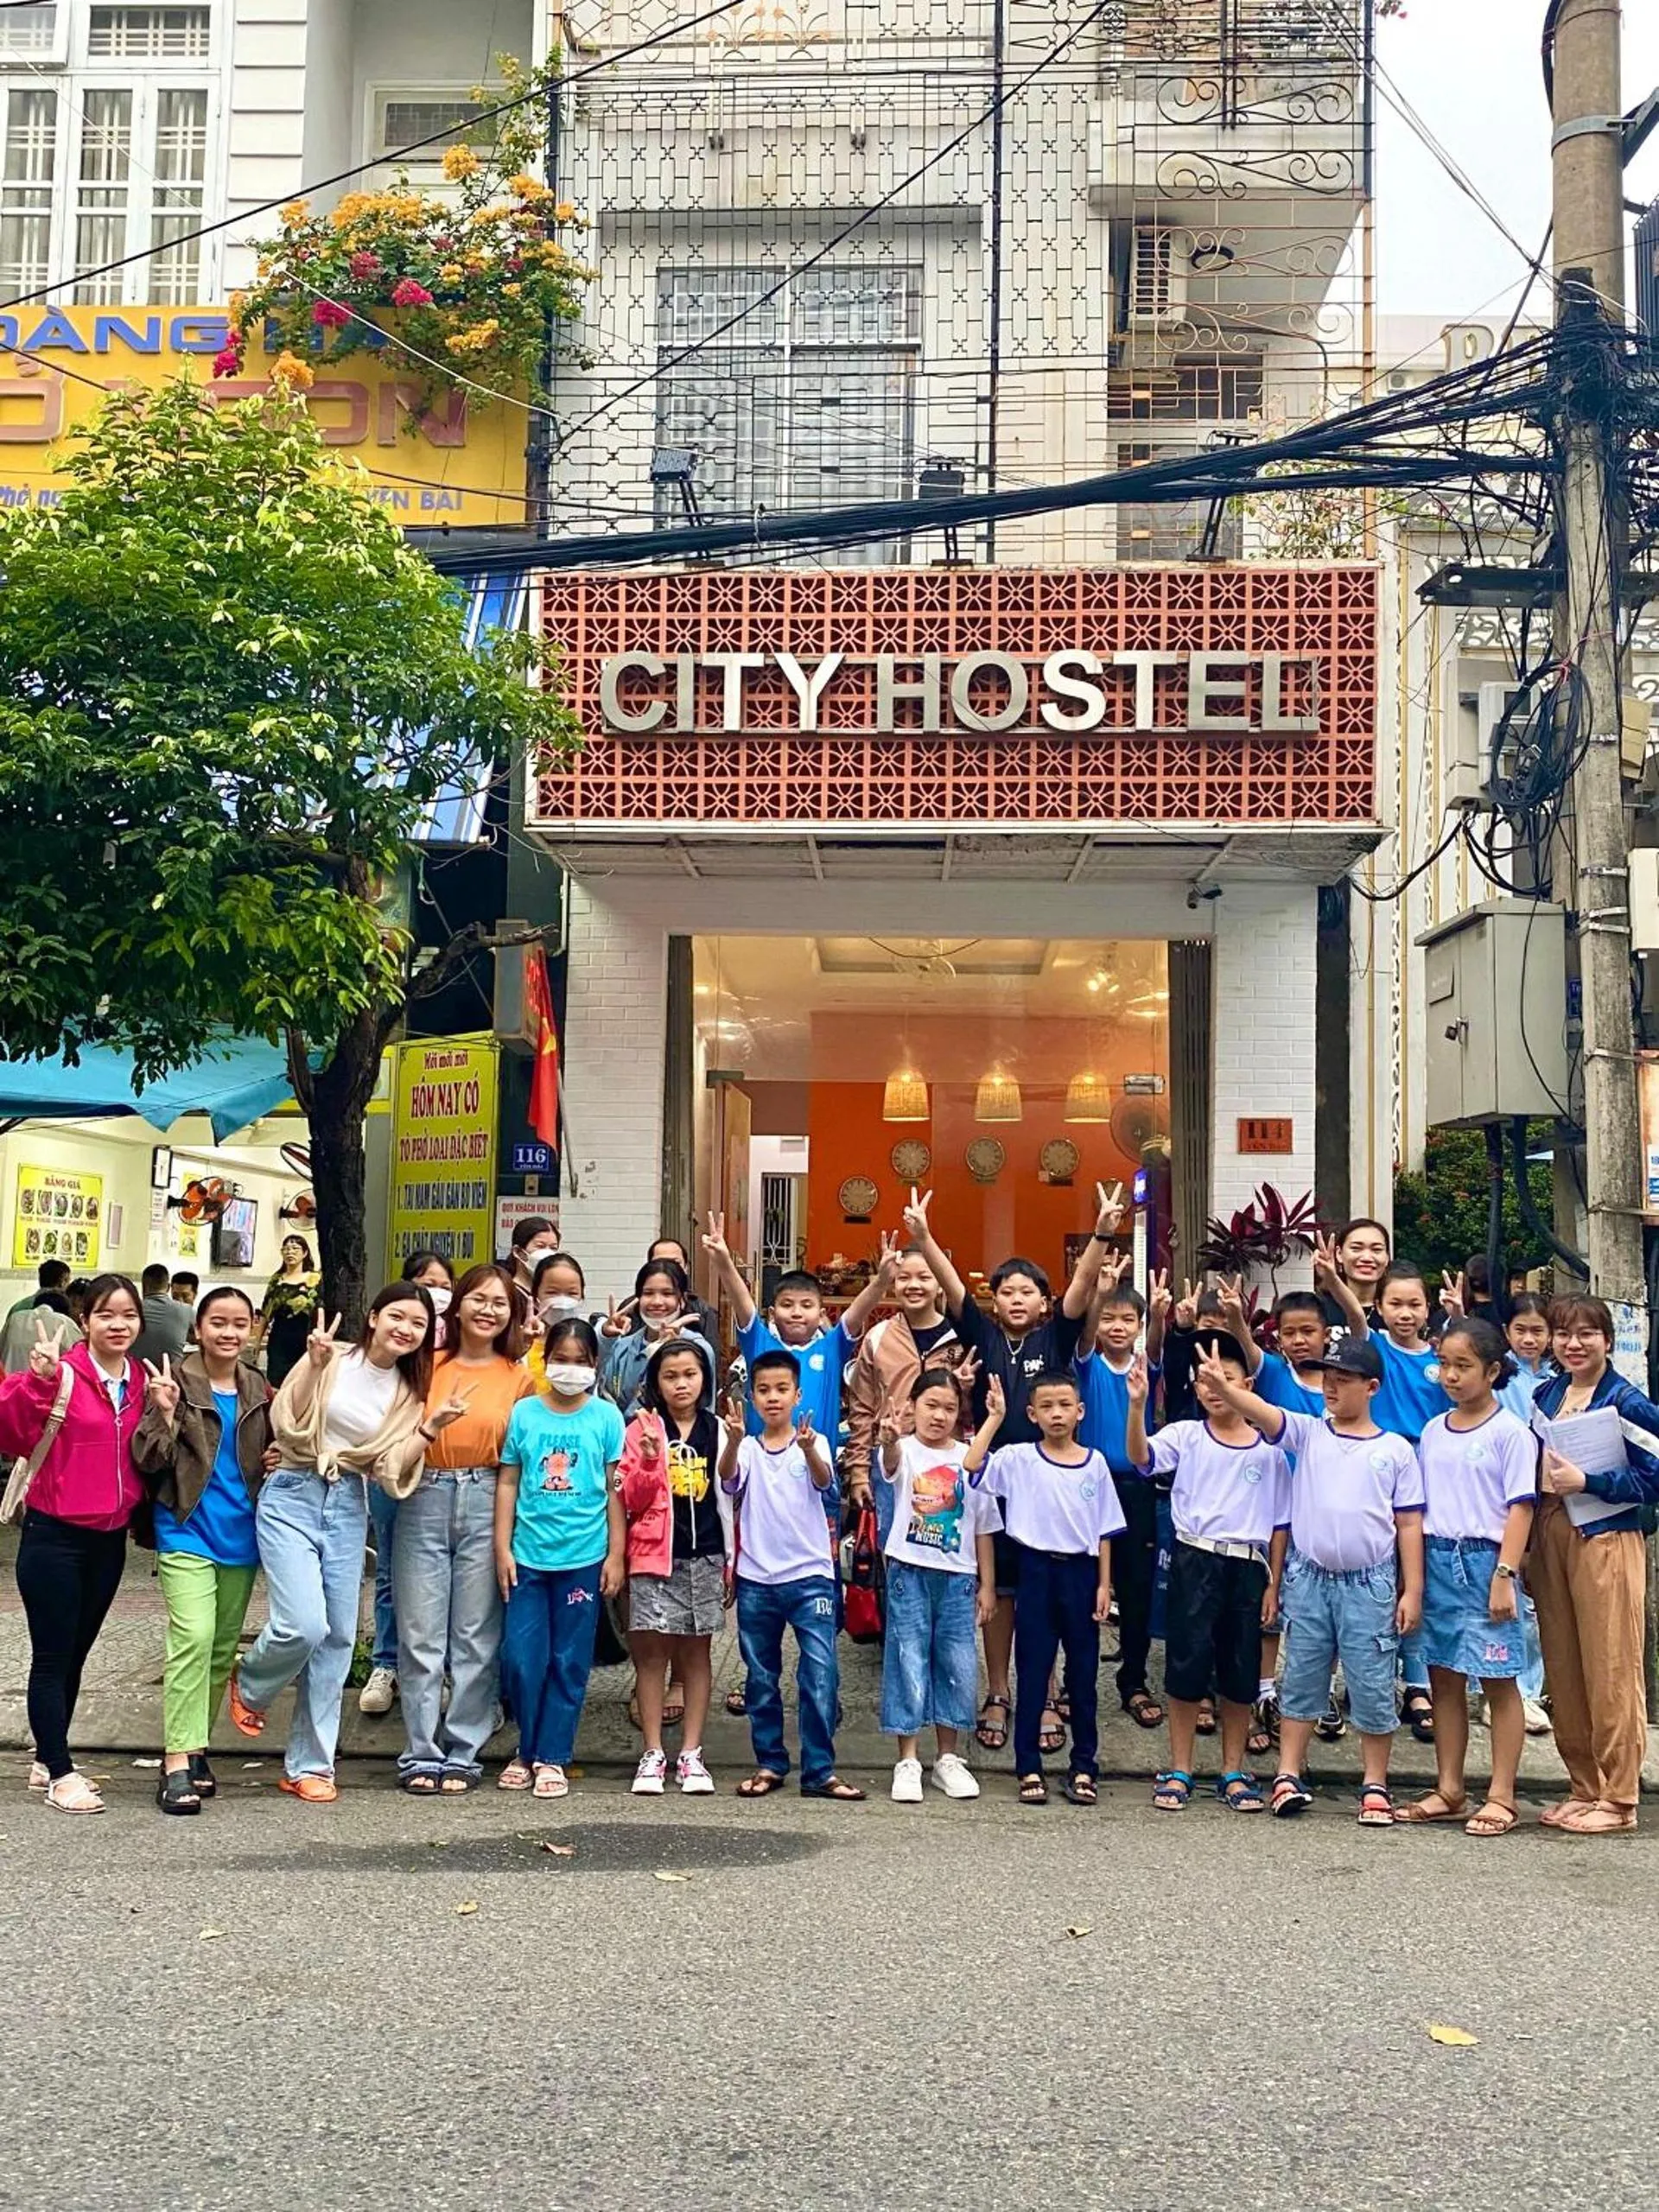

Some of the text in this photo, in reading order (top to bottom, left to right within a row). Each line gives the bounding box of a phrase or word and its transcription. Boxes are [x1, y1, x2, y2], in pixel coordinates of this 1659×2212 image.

[0, 305, 230, 354] ÀNG
[600, 649, 1319, 733] CITY HOSTEL
[437, 1081, 462, 1116] NAY
[464, 1070, 480, 1115] CÓ
[516, 1147, 547, 1164] 116
[539, 1433, 582, 1449] PLEASE
